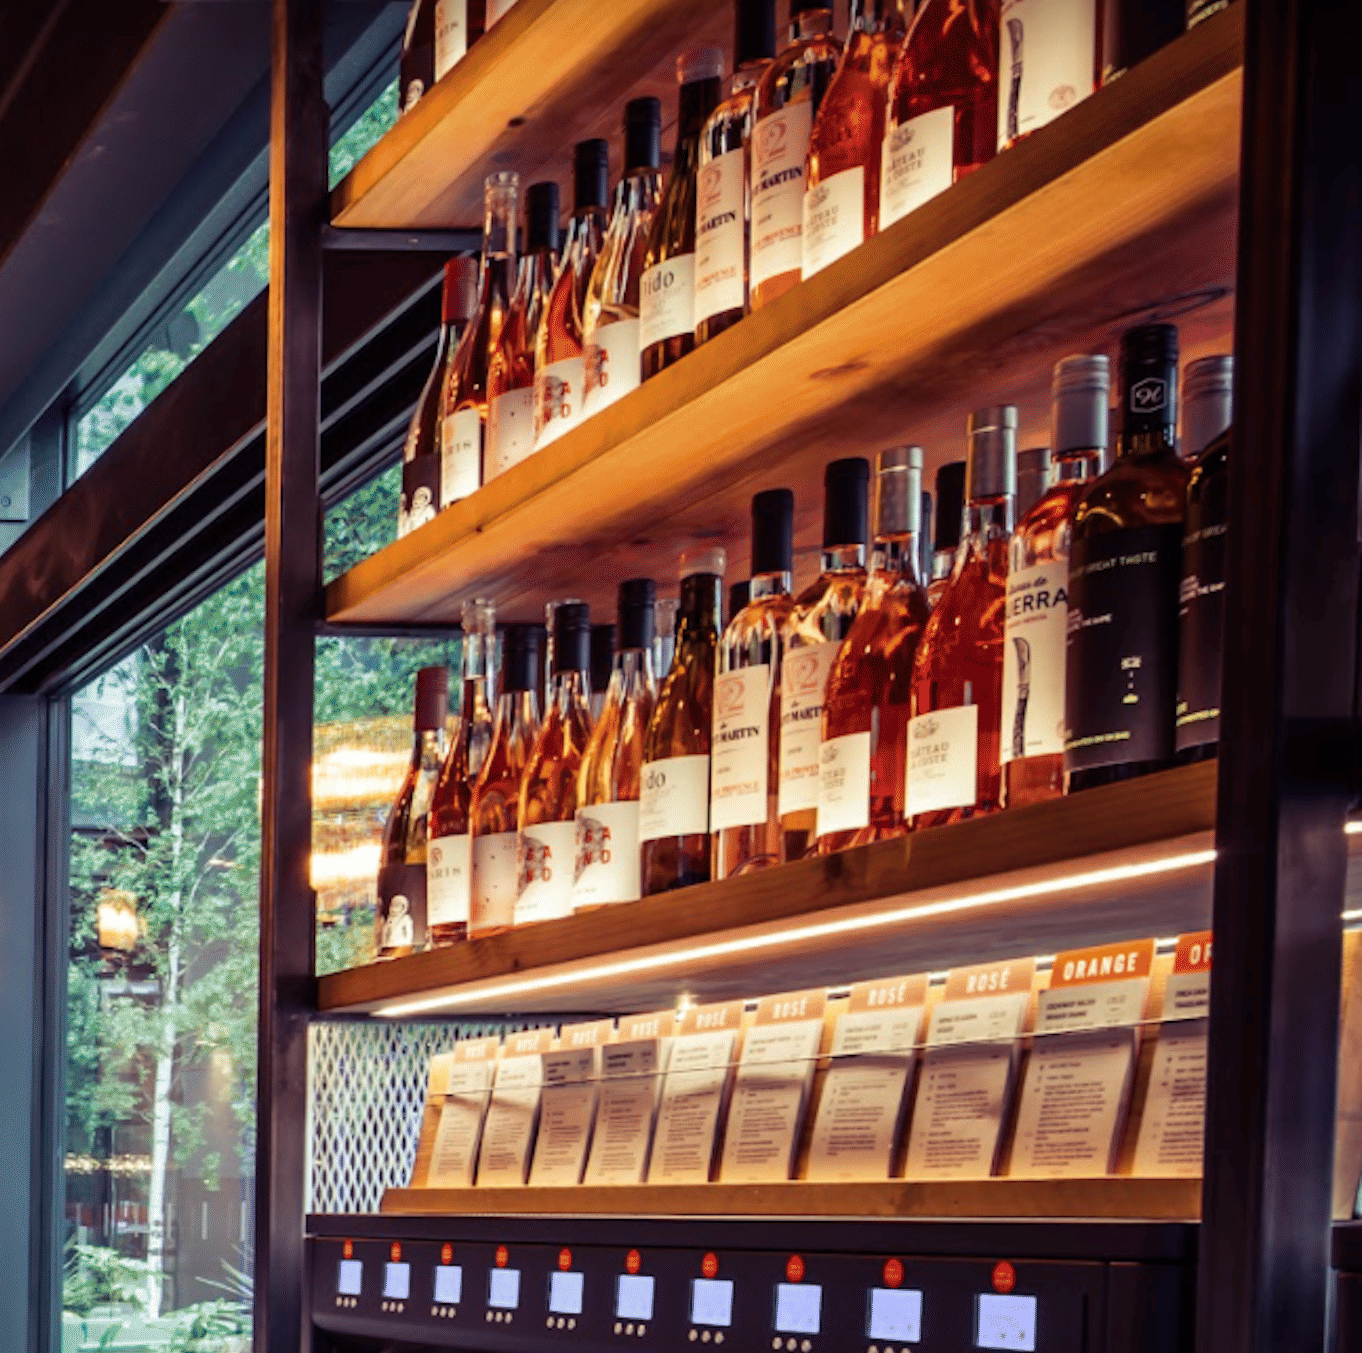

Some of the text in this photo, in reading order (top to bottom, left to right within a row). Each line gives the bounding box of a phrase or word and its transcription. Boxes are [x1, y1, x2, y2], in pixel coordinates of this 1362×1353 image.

[761, 166, 804, 191] MARTIN
[1119, 551, 1157, 566] TASTE
[1061, 951, 1139, 982] ORANGE
[965, 966, 1011, 993] ROSÉ
[867, 982, 907, 1006] ROSÉ
[771, 998, 808, 1020] ROSÉ
